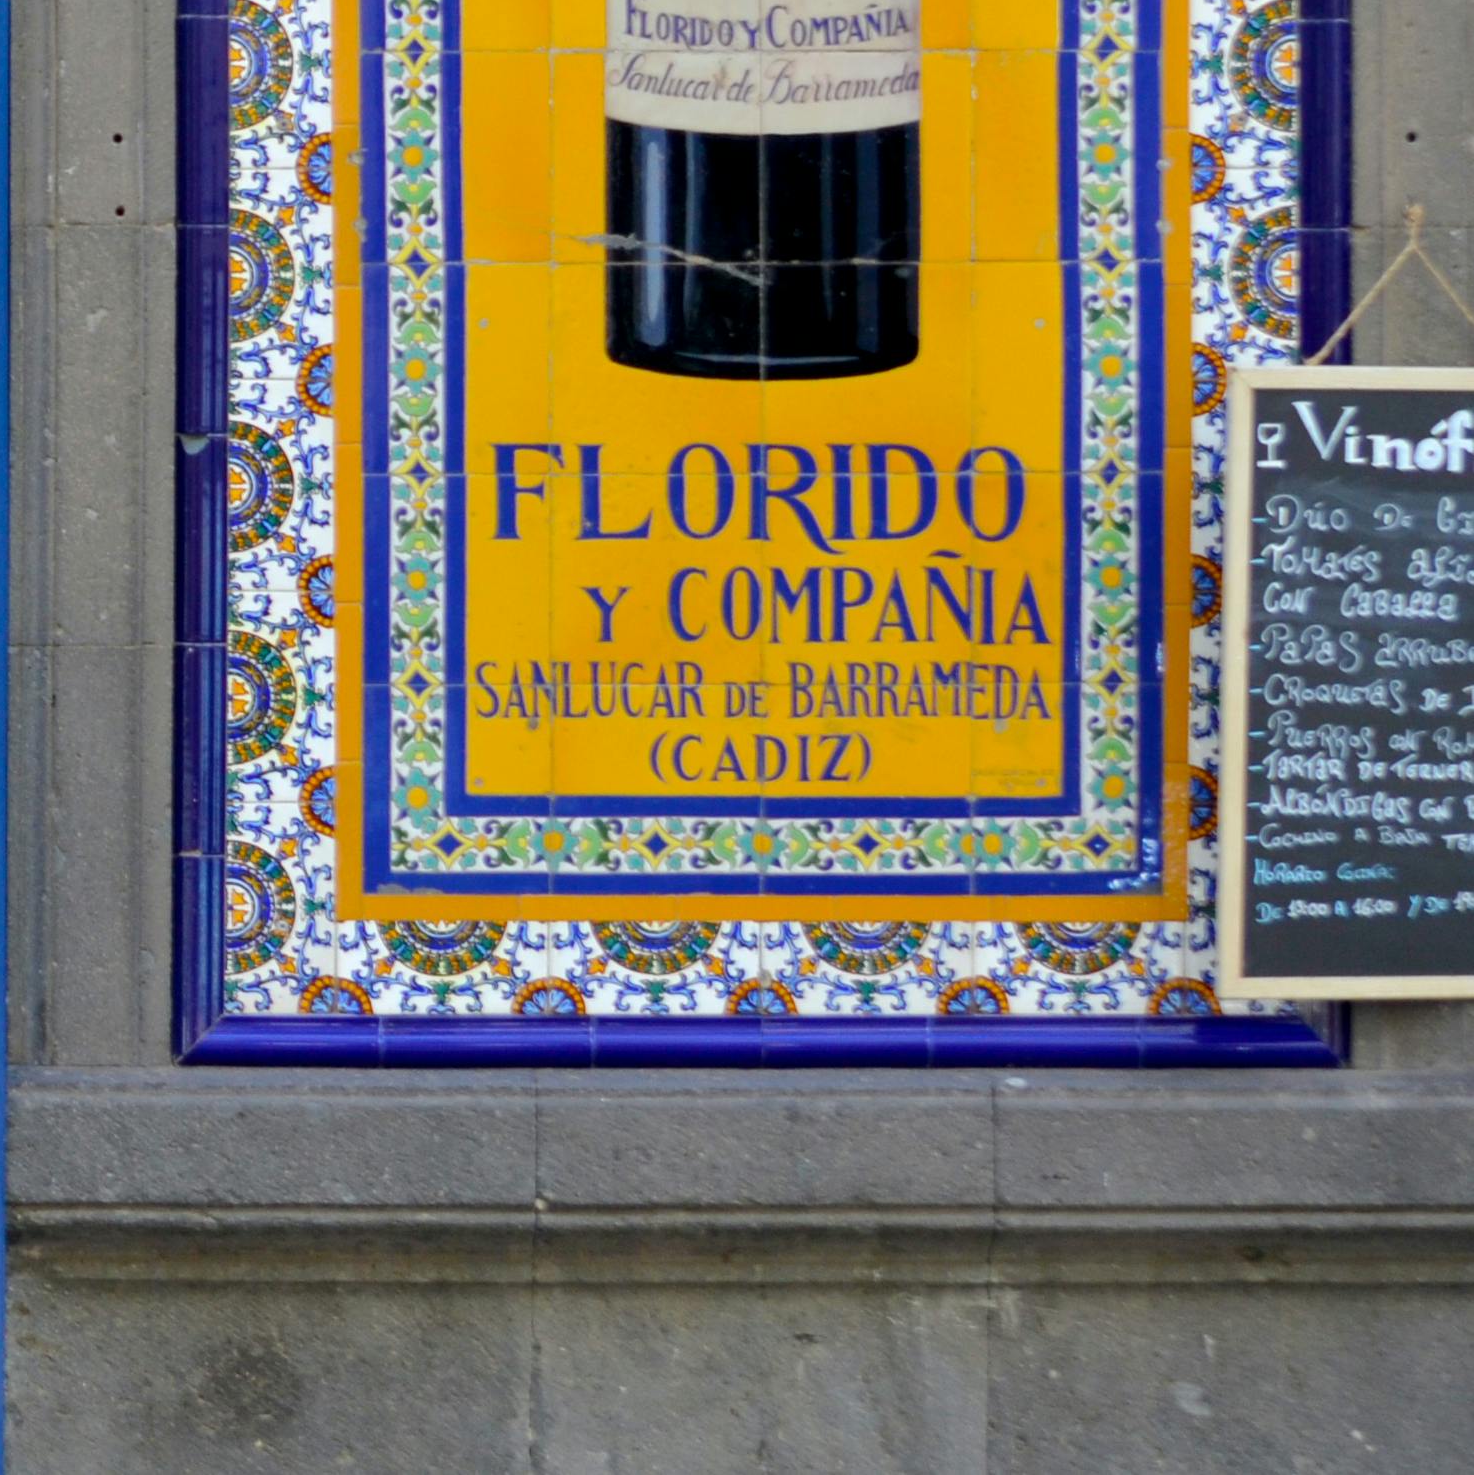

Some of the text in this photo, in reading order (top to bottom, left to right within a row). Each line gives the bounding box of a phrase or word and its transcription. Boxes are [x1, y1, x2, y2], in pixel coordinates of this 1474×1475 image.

[740, 19, 759, 49] Y
[609, 52, 920, 105] Sanlucar de Barrameda
[490, 442, 1026, 555] FLORIDO
[581, 549, 1052, 645] Y COMPAÑIA
[474, 661, 1052, 721] SANLUCAR DE BARRAMEDA
[650, 732, 872, 784] (CADIZ)
[1334, 900, 1349, 917] A
